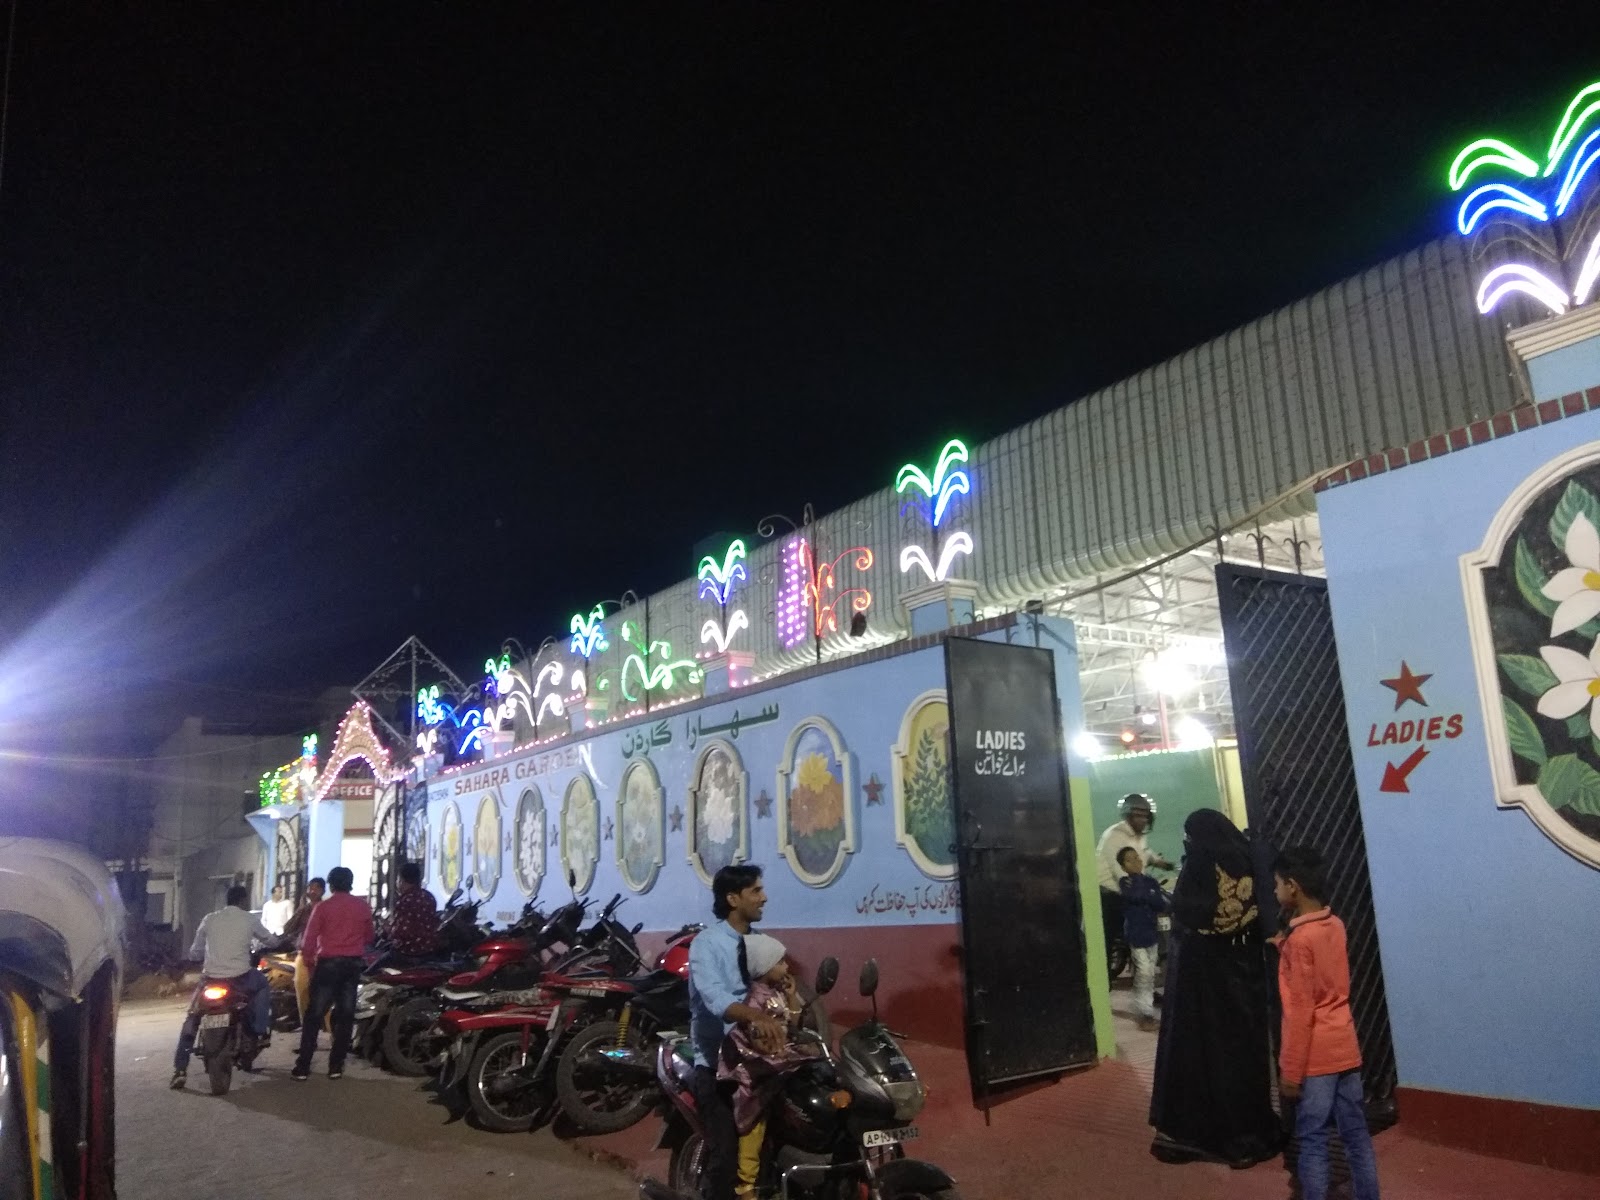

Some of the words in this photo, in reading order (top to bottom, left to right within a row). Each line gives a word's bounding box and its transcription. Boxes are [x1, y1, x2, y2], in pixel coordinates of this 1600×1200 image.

[976, 730, 1026, 750] LADIES
[1367, 713, 1463, 748] LADIES
[455, 770, 510, 796] SAHARA
[515, 745, 591, 780] GARDE
[331, 785, 373, 797] OFFICE
